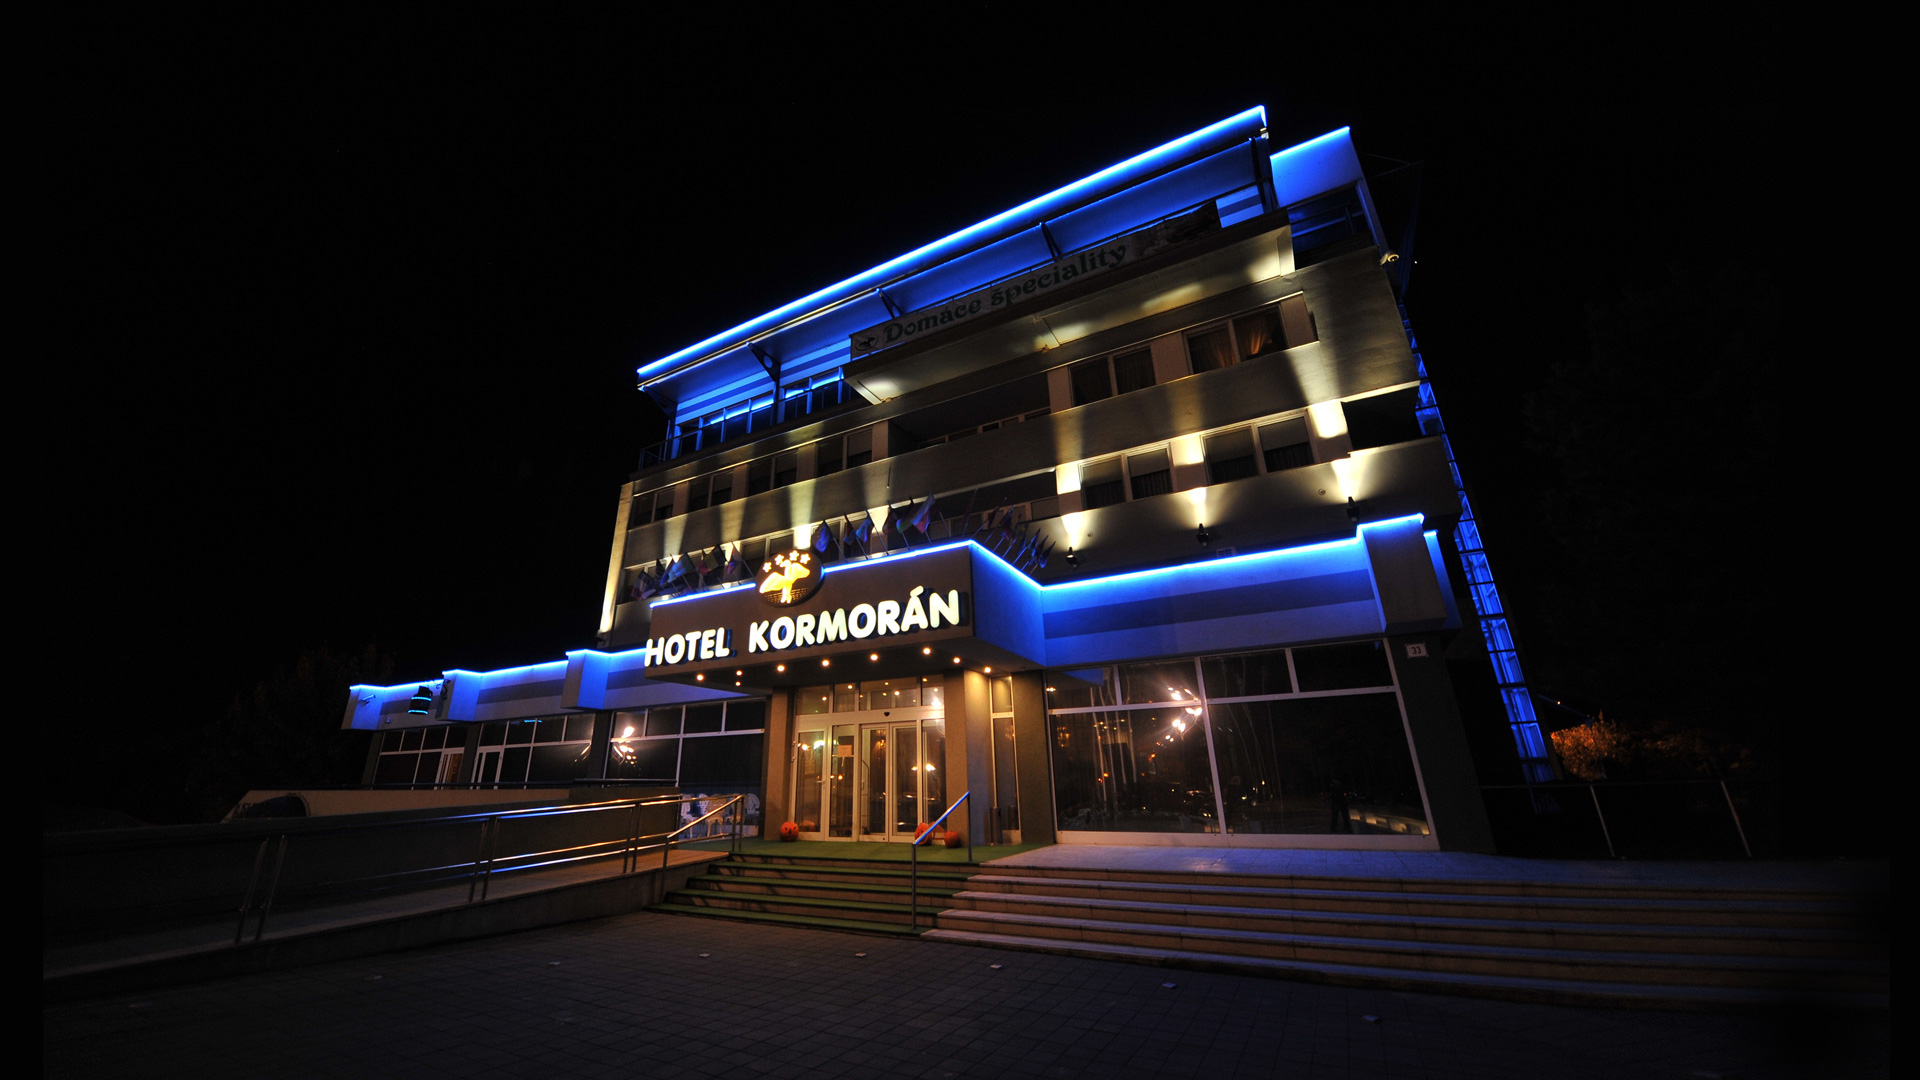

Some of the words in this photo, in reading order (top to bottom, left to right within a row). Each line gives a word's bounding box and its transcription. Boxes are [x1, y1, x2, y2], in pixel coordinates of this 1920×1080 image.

[883, 300, 981, 343] Domáce
[991, 245, 1126, 307] špeciality
[644, 626, 730, 667] HOTEL
[748, 585, 960, 653] KORMORÁN
[1411, 646, 1422, 655] 33
